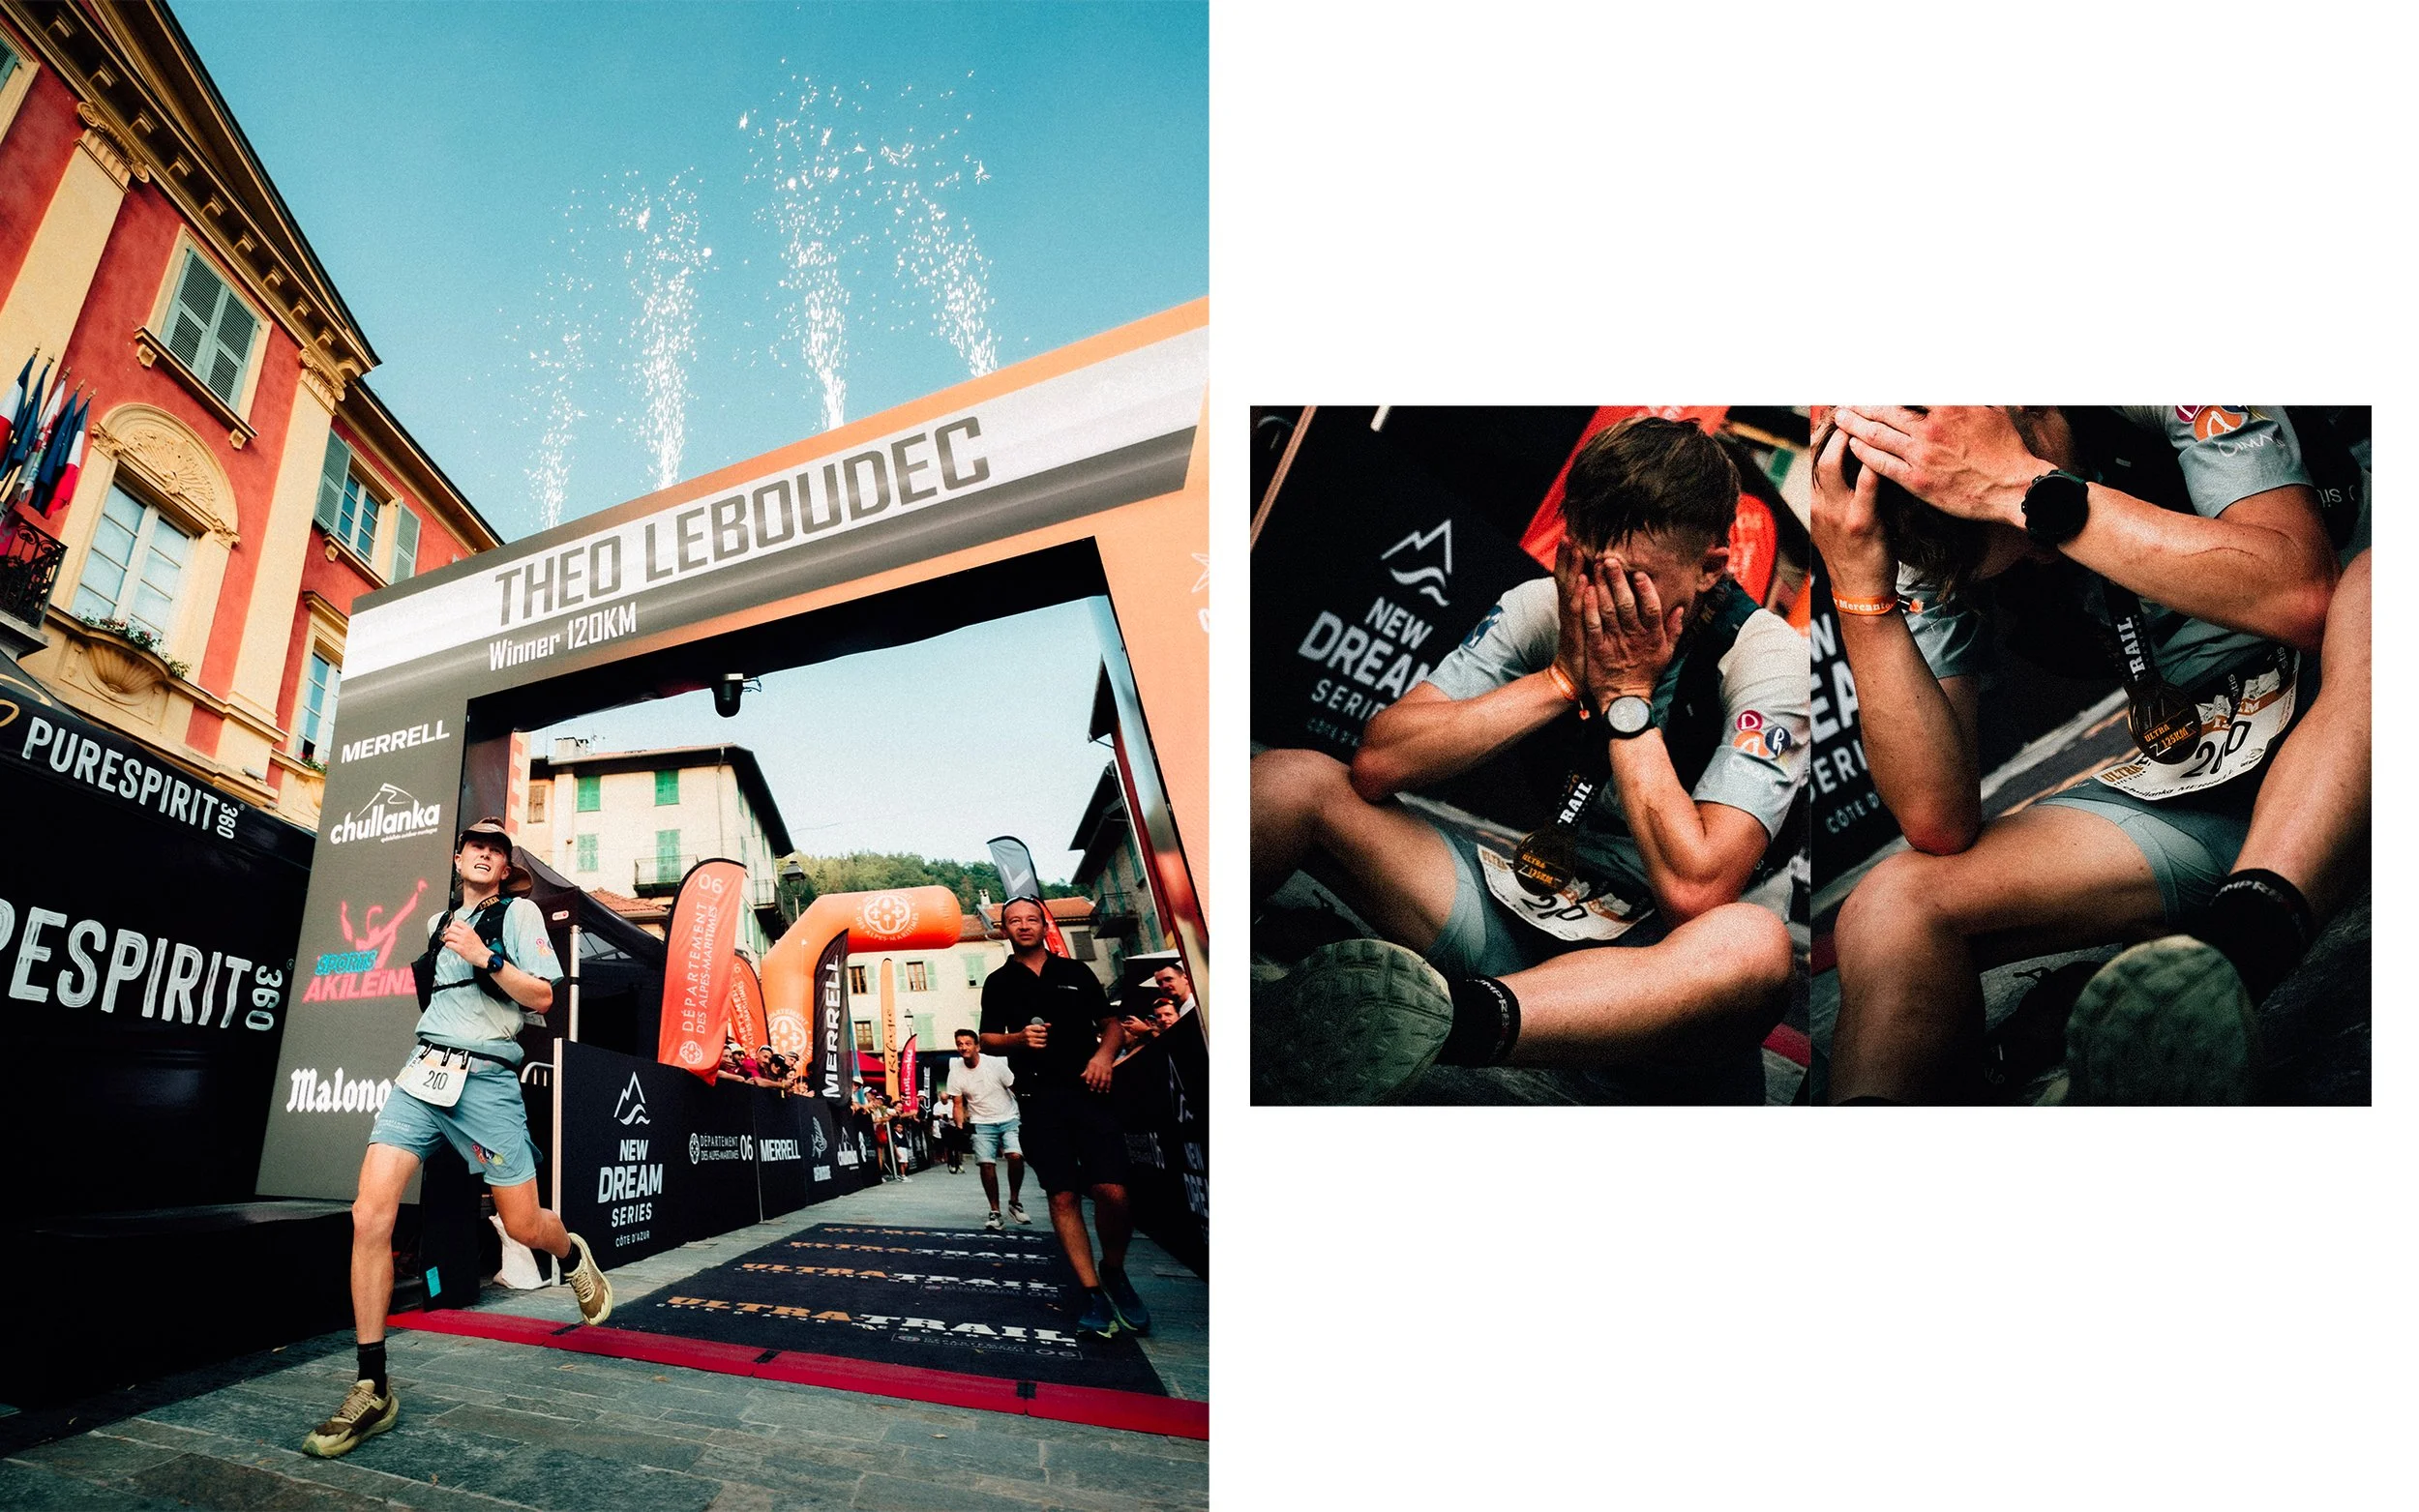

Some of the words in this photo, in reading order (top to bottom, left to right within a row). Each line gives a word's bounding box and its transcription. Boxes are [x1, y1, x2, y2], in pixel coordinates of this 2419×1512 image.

[495, 534, 621, 627] THEO
[644, 415, 991, 583] LEBOUDEC
[489, 630, 561, 672] Winner
[566, 601, 638, 650] 120KM
[1363, 596, 1434, 651] NEW
[341, 719, 450, 764] MERRELL
[2144, 724, 2170, 743] ULTRA
[2161, 726, 2190, 749] 125KM
[21, 716, 219, 831] PURESPIRIT
[330, 798, 441, 845] chullanka
[698, 873, 724, 895] 06
[314, 949, 378, 976] SPORTS
[682, 904, 708, 1033] DÉPARTEMENT
[821, 954, 842, 1099] MERRELL
[619, 1139, 649, 1162] NEW
[740, 1134, 754, 1162] 06
[760, 1139, 801, 1163] MERRELL
[597, 1163, 664, 1204] DREAM
[611, 1201, 653, 1229] SERIES
[741, 1262, 888, 1278] ULTRA
[667, 1295, 851, 1321] ULTRA
[859, 1314, 1076, 1344] TRAIL
